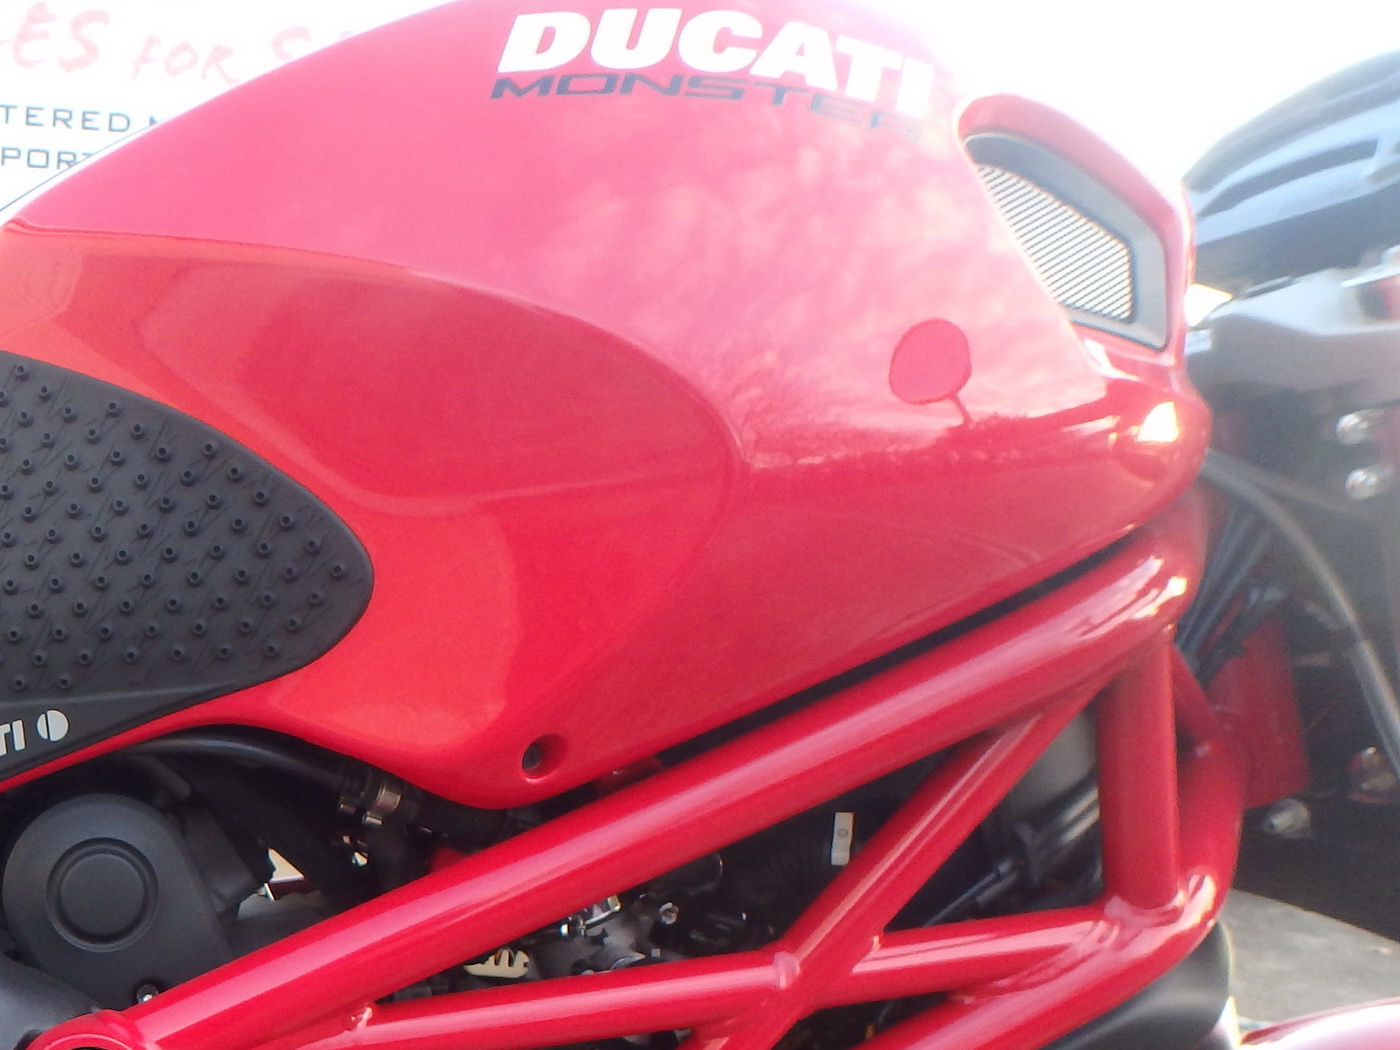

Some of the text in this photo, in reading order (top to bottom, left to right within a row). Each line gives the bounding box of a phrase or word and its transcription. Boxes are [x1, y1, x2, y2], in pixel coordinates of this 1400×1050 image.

[132, 34, 243, 85] FOR
[496, 7, 935, 119] DUCATI
[490, 73, 923, 143] MONSTER
